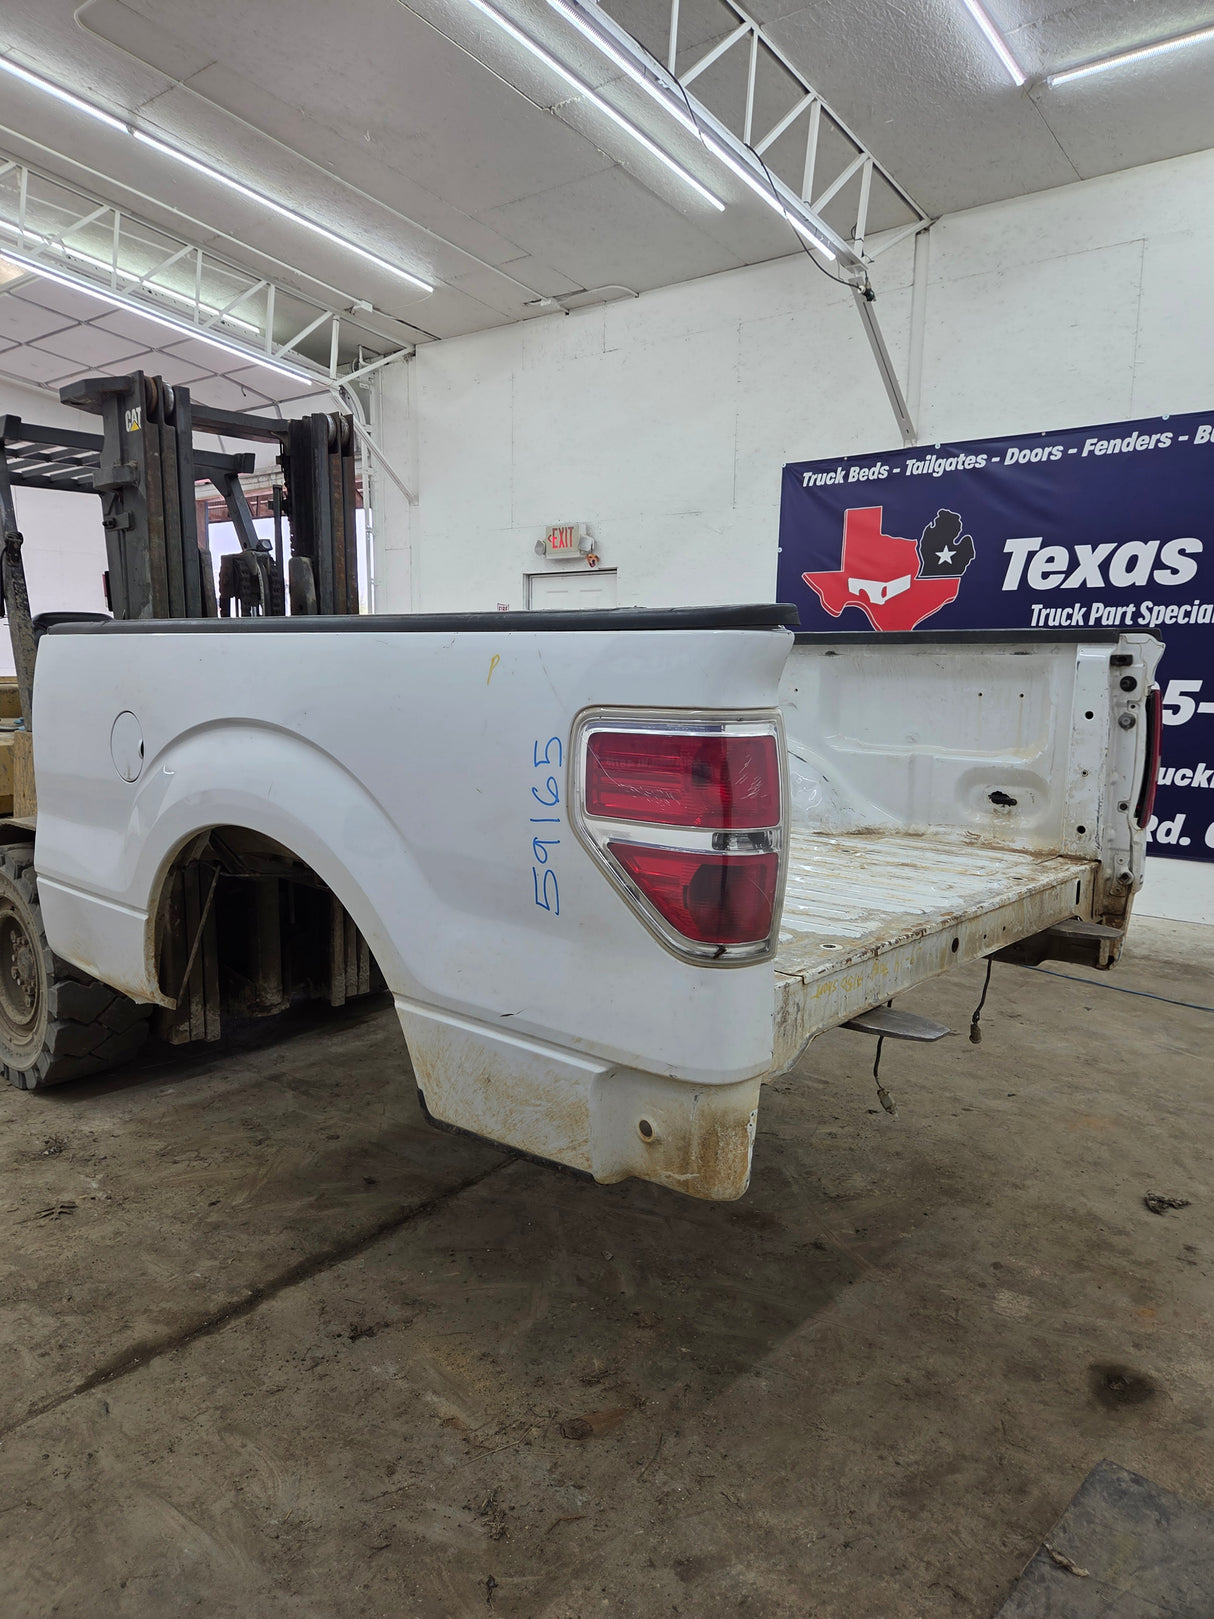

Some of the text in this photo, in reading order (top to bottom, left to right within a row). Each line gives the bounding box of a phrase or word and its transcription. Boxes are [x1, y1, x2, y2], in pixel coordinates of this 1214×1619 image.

[125, 406, 142, 432] CAT
[802, 467, 844, 488] Truck
[848, 462, 889, 484] Beds
[905, 453, 988, 478] Tailgates
[1004, 445, 1063, 466] Doors
[1081, 431, 1174, 457] Fenders
[1193, 424, 1214, 445] B
[552, 526, 575, 549] EXIT
[1002, 537, 1204, 591] Texas
[1031, 600, 1214, 628] Truck Part Specia
[1152, 679, 1214, 726] 5-
[1157, 762, 1214, 789] uck
[530, 736, 563, 917] 59165
